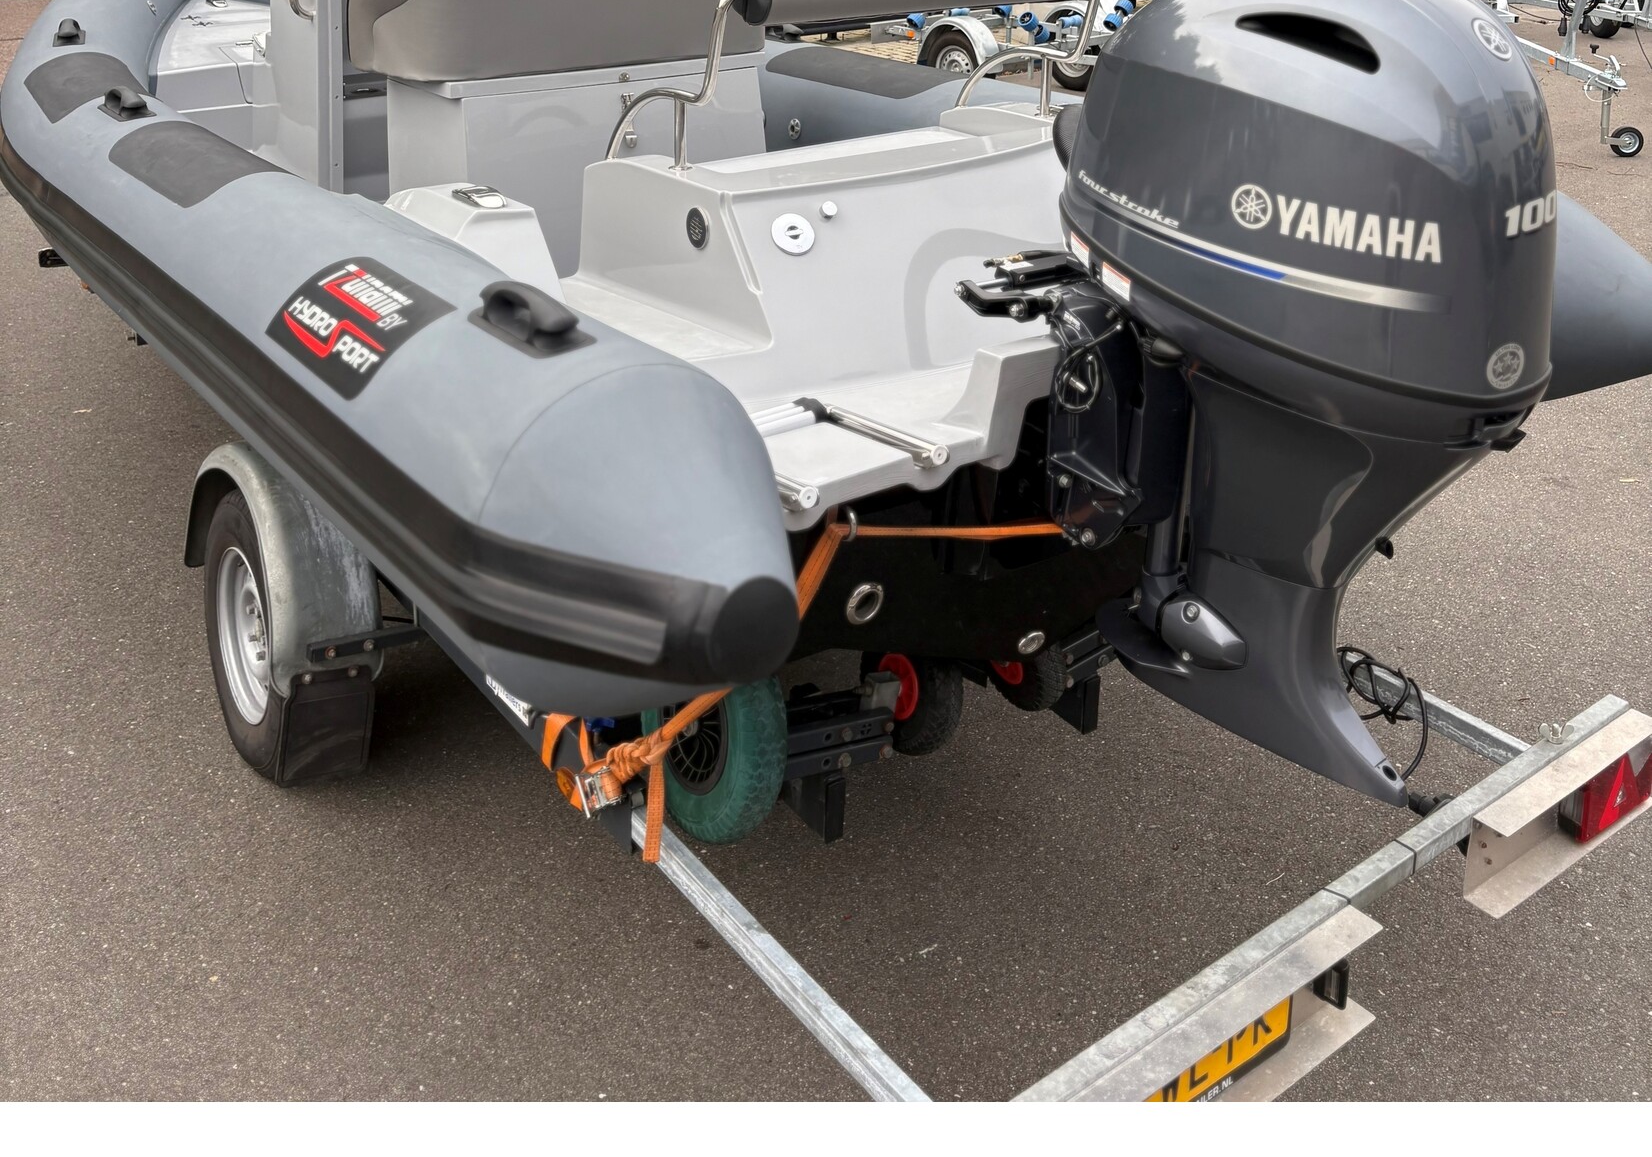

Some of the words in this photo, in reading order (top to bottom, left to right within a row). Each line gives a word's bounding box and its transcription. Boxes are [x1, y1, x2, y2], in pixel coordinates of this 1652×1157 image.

[1276, 194, 1442, 264] YAMAHA
[1505, 189, 1557, 237] 100
[376, 313, 408, 331] BY
